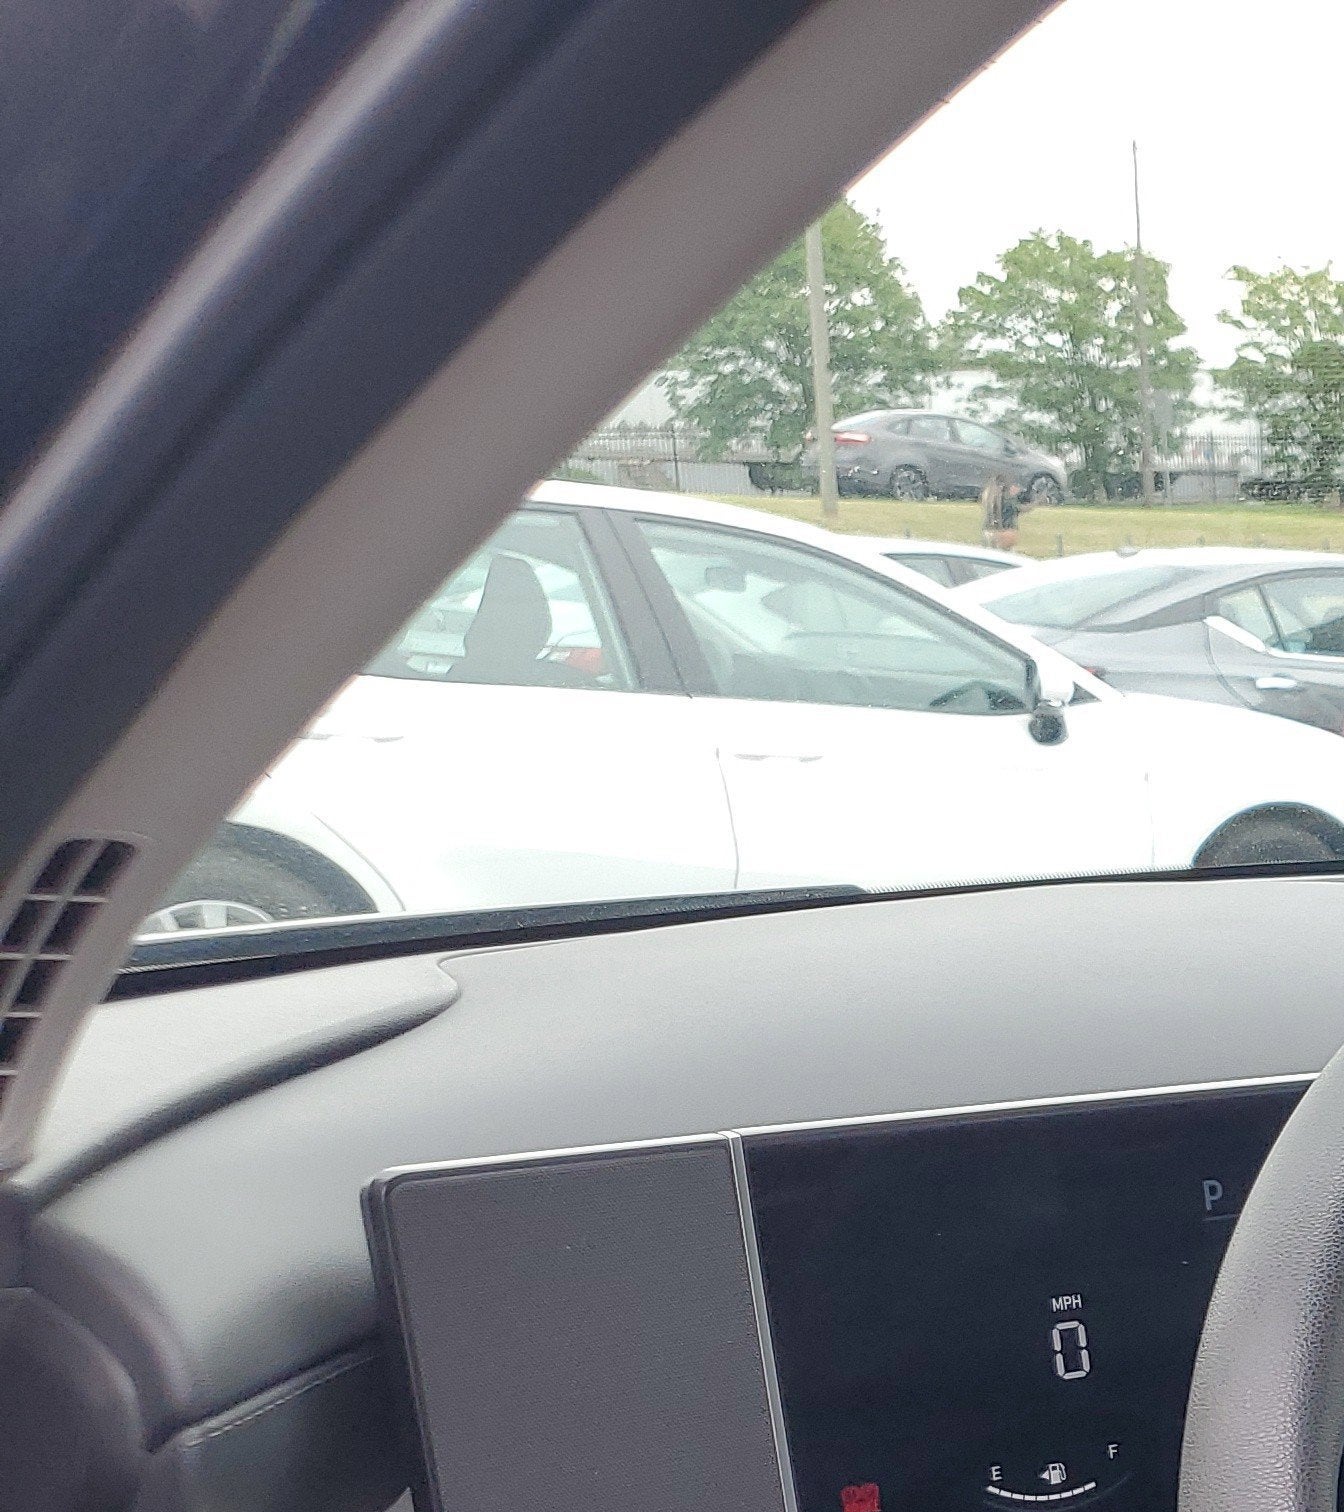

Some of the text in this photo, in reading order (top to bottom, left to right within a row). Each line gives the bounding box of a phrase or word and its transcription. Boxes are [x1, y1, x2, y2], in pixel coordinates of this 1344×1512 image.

[1203, 1179, 1223, 1210] P
[1052, 1294, 1083, 1312] MPH
[1052, 1320, 1091, 1380] 0
[1107, 1443, 1119, 1460] F
[990, 1465, 1003, 1482] E
